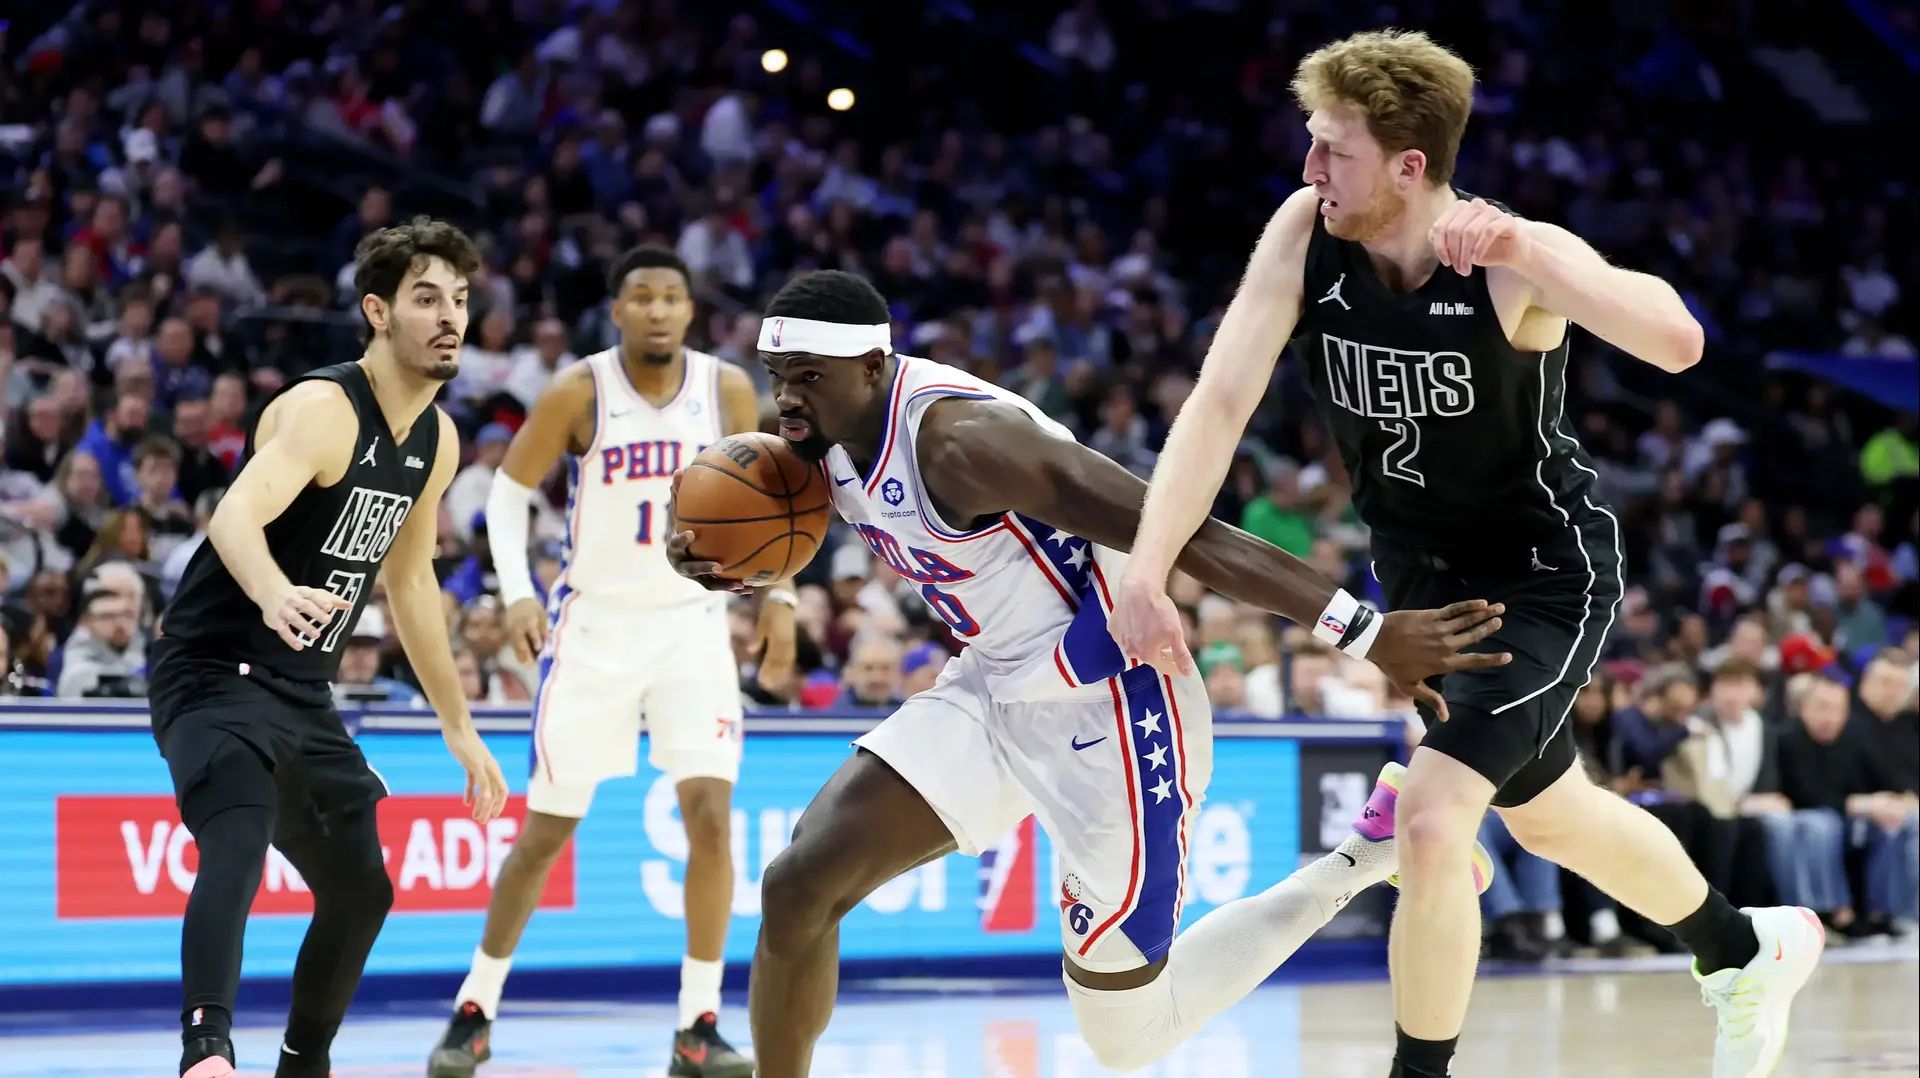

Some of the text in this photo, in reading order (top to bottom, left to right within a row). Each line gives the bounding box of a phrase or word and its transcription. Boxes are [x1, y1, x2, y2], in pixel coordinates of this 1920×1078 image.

[1429, 302, 1442, 315] All
[1444, 302, 1454, 315] In
[1322, 333, 1475, 418] NETS
[601, 440, 689, 484] PHIL
[1378, 416, 1425, 488] 2
[320, 487, 412, 563] NETS
[881, 510, 917, 519] crypto.com
